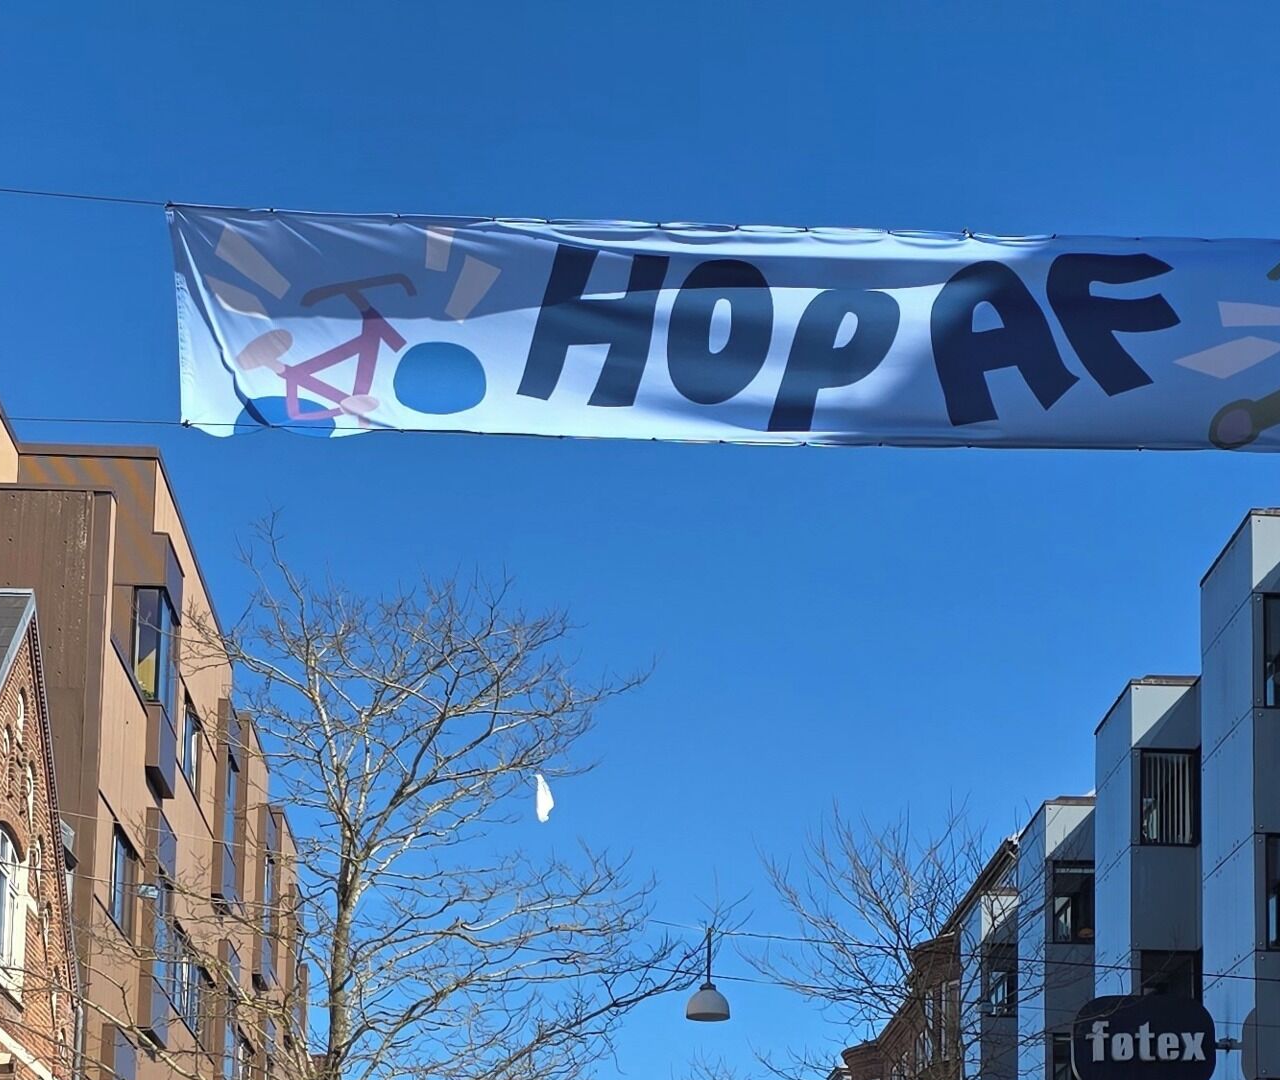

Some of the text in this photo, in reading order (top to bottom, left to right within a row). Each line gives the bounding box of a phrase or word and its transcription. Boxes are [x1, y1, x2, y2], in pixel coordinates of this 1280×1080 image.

[517, 244, 1181, 432] HOP AF
[1085, 1020, 1206, 1062] føtex
